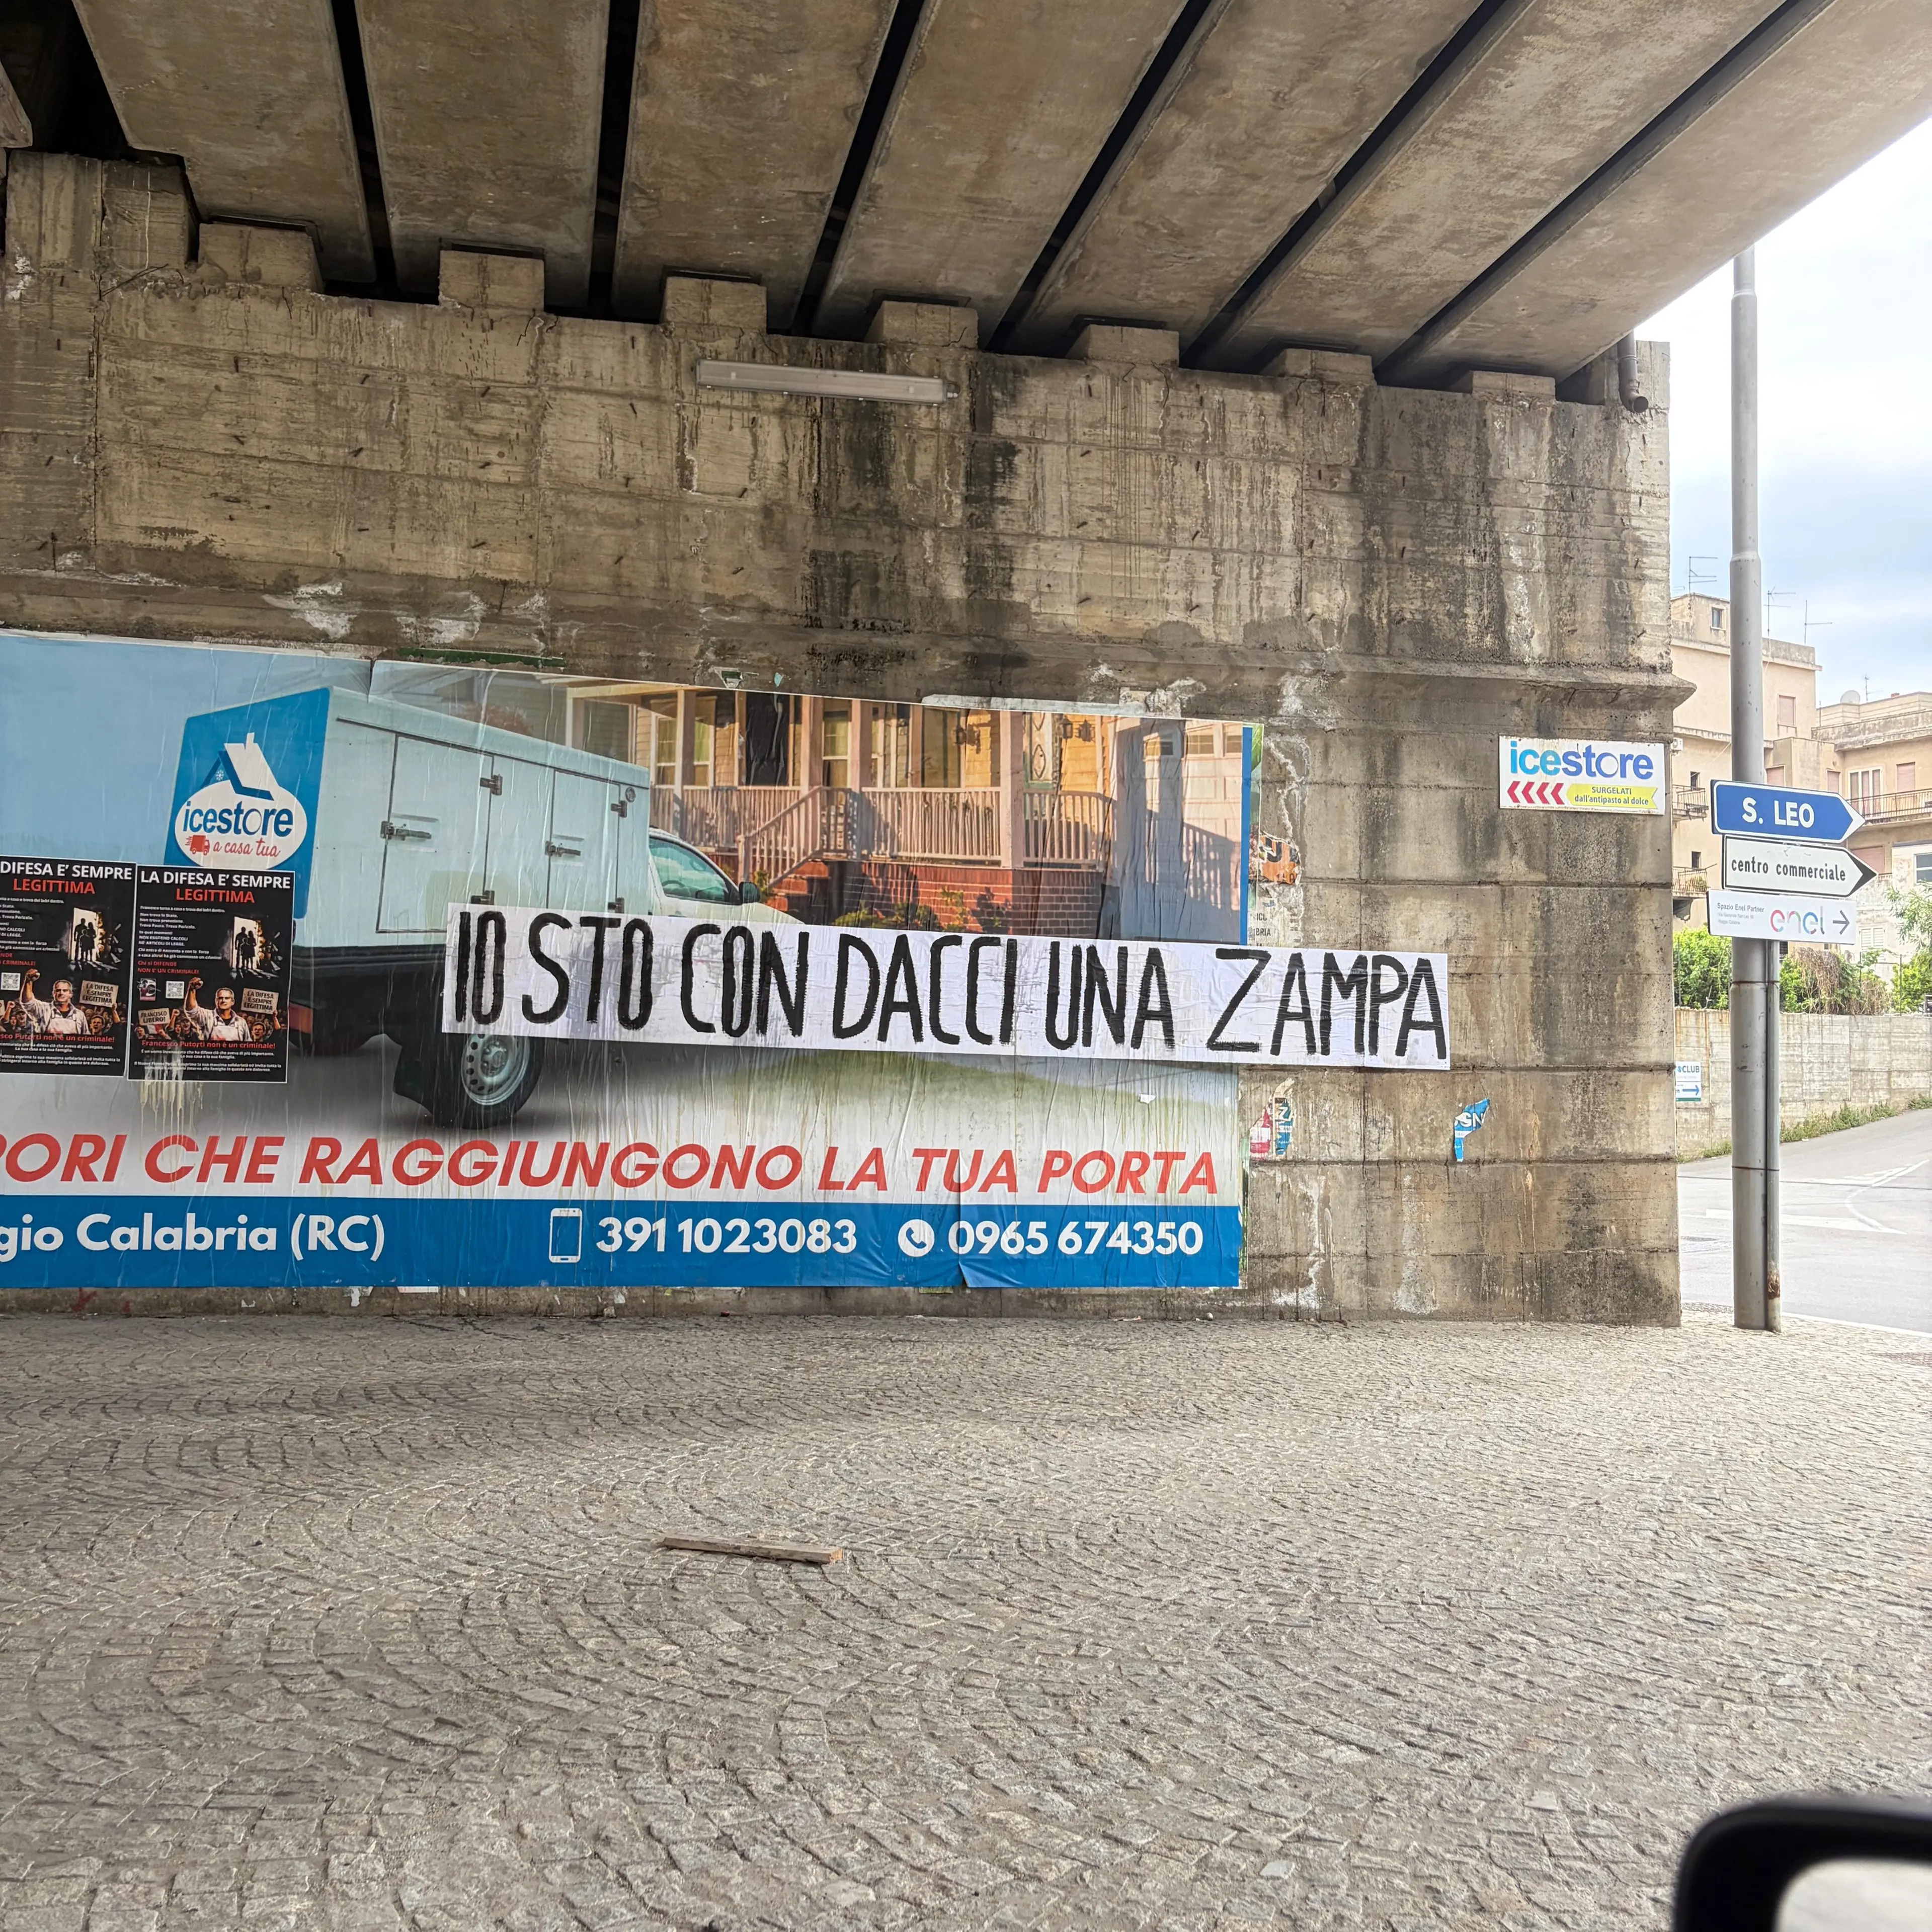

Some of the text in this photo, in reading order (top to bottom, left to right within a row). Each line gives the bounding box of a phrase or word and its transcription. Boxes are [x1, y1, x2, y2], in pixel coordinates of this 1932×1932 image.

[1510, 740, 1653, 780] icestore
[1574, 794, 1622, 804] dall'antipasto
[1631, 797, 1649, 805] dolce
[1591, 786, 1632, 795] SURGELATI
[183, 800, 293, 837] icestore
[1742, 797, 1815, 828] S. LEO
[213, 837, 281, 857] a casa tua
[1, 861, 132, 880] DIFESA E' SEMPRE
[140, 870, 291, 889] LA DIFESA E' SEMPRE
[1731, 856, 1846, 881] centro commerciale
[13, 878, 95, 894] LEGITTIMA
[176, 888, 255, 903] LEGITTIMA
[1717, 902, 1733, 911] Spazio
[1770, 906, 1825, 935] enel
[455, 910, 1447, 1060] IO STO CON DACCI UNA ZAMPA
[83, 995, 112, 1003] LEGITTIMA
[244, 1002, 273, 1011] LEGITTIMA
[0, 1133, 1218, 1194] ORI CHE RAGGIUNGONO LA TUA PORTA
[76, 1213, 277, 1252] Calabria
[290, 1213, 384, 1262] (RC)
[596, 1217, 857, 1254] 391 1023083
[948, 1221, 1203, 1255] 0965 674350
